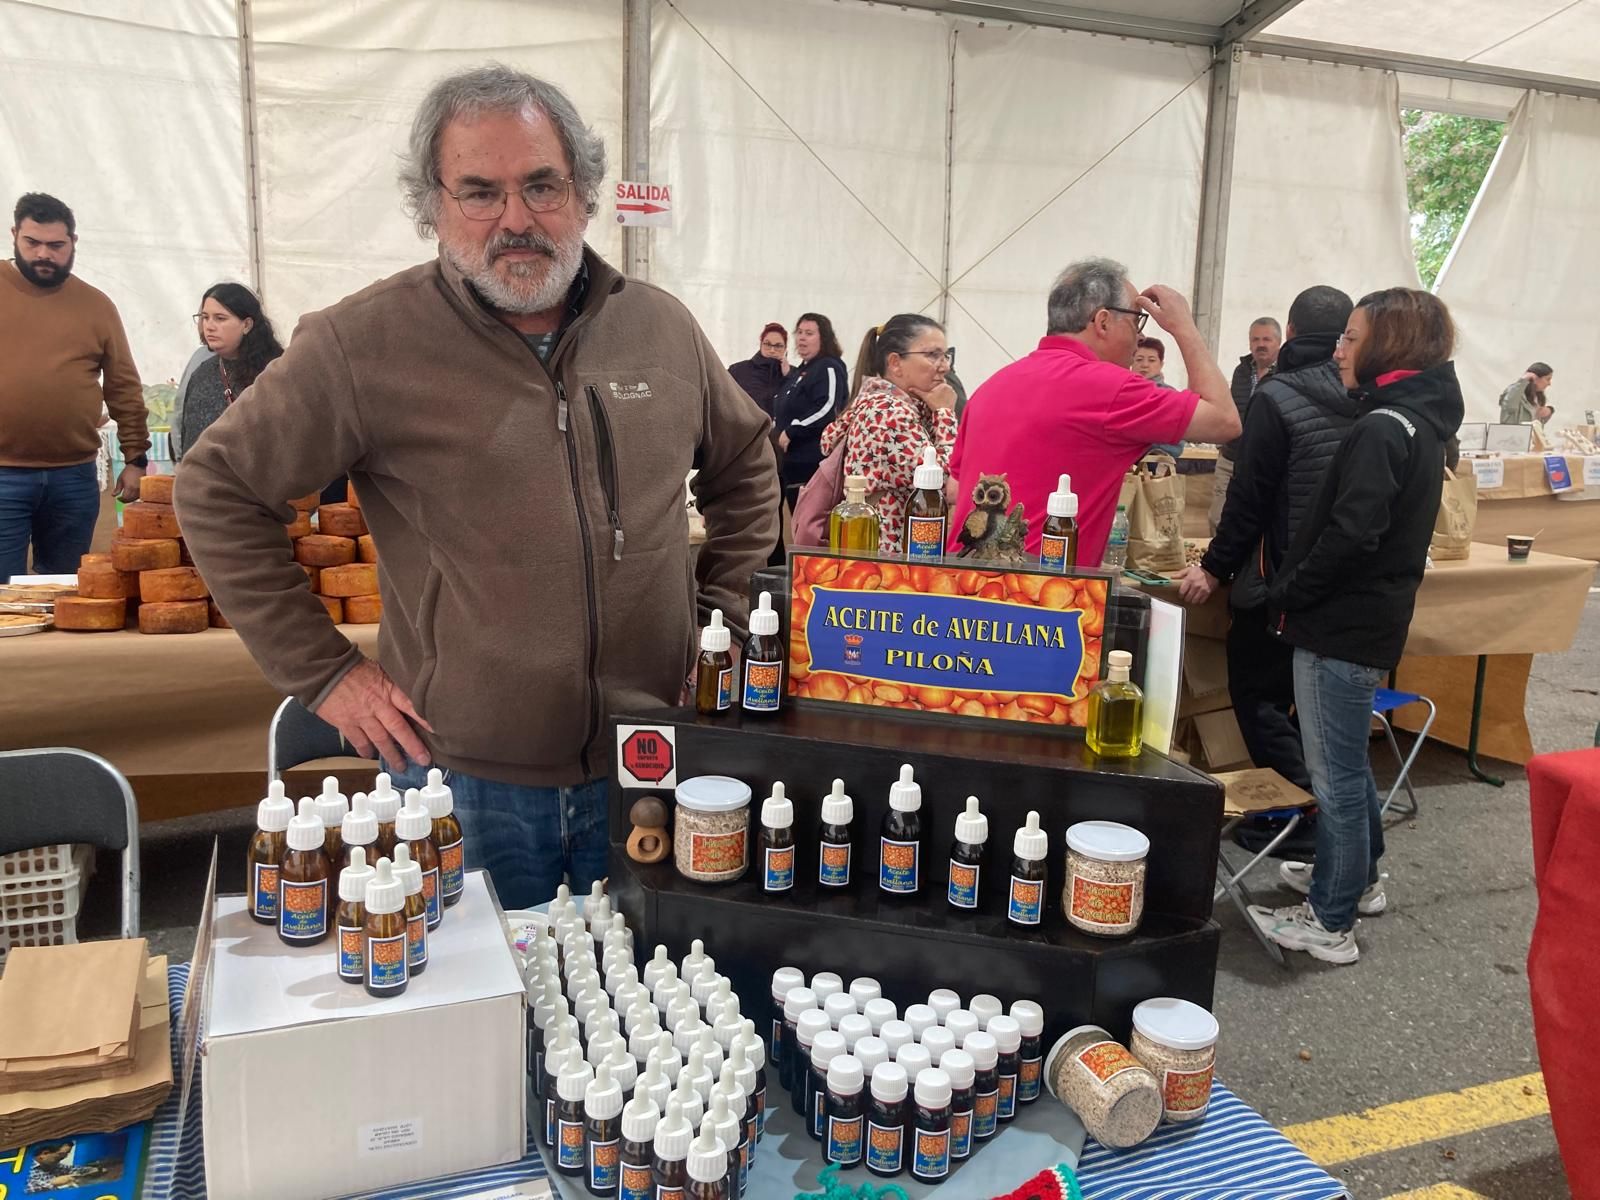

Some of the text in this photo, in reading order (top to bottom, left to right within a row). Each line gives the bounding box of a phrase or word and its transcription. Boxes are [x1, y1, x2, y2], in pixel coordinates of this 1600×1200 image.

[616, 183, 670, 202] SALIDA
[824, 606, 1066, 649] ACEITE de AVELLANA
[885, 648, 994, 676] PILOÑA
[637, 738, 657, 755] NO
[882, 877, 913, 885] Avellana
[284, 923, 321, 931] Avellana
